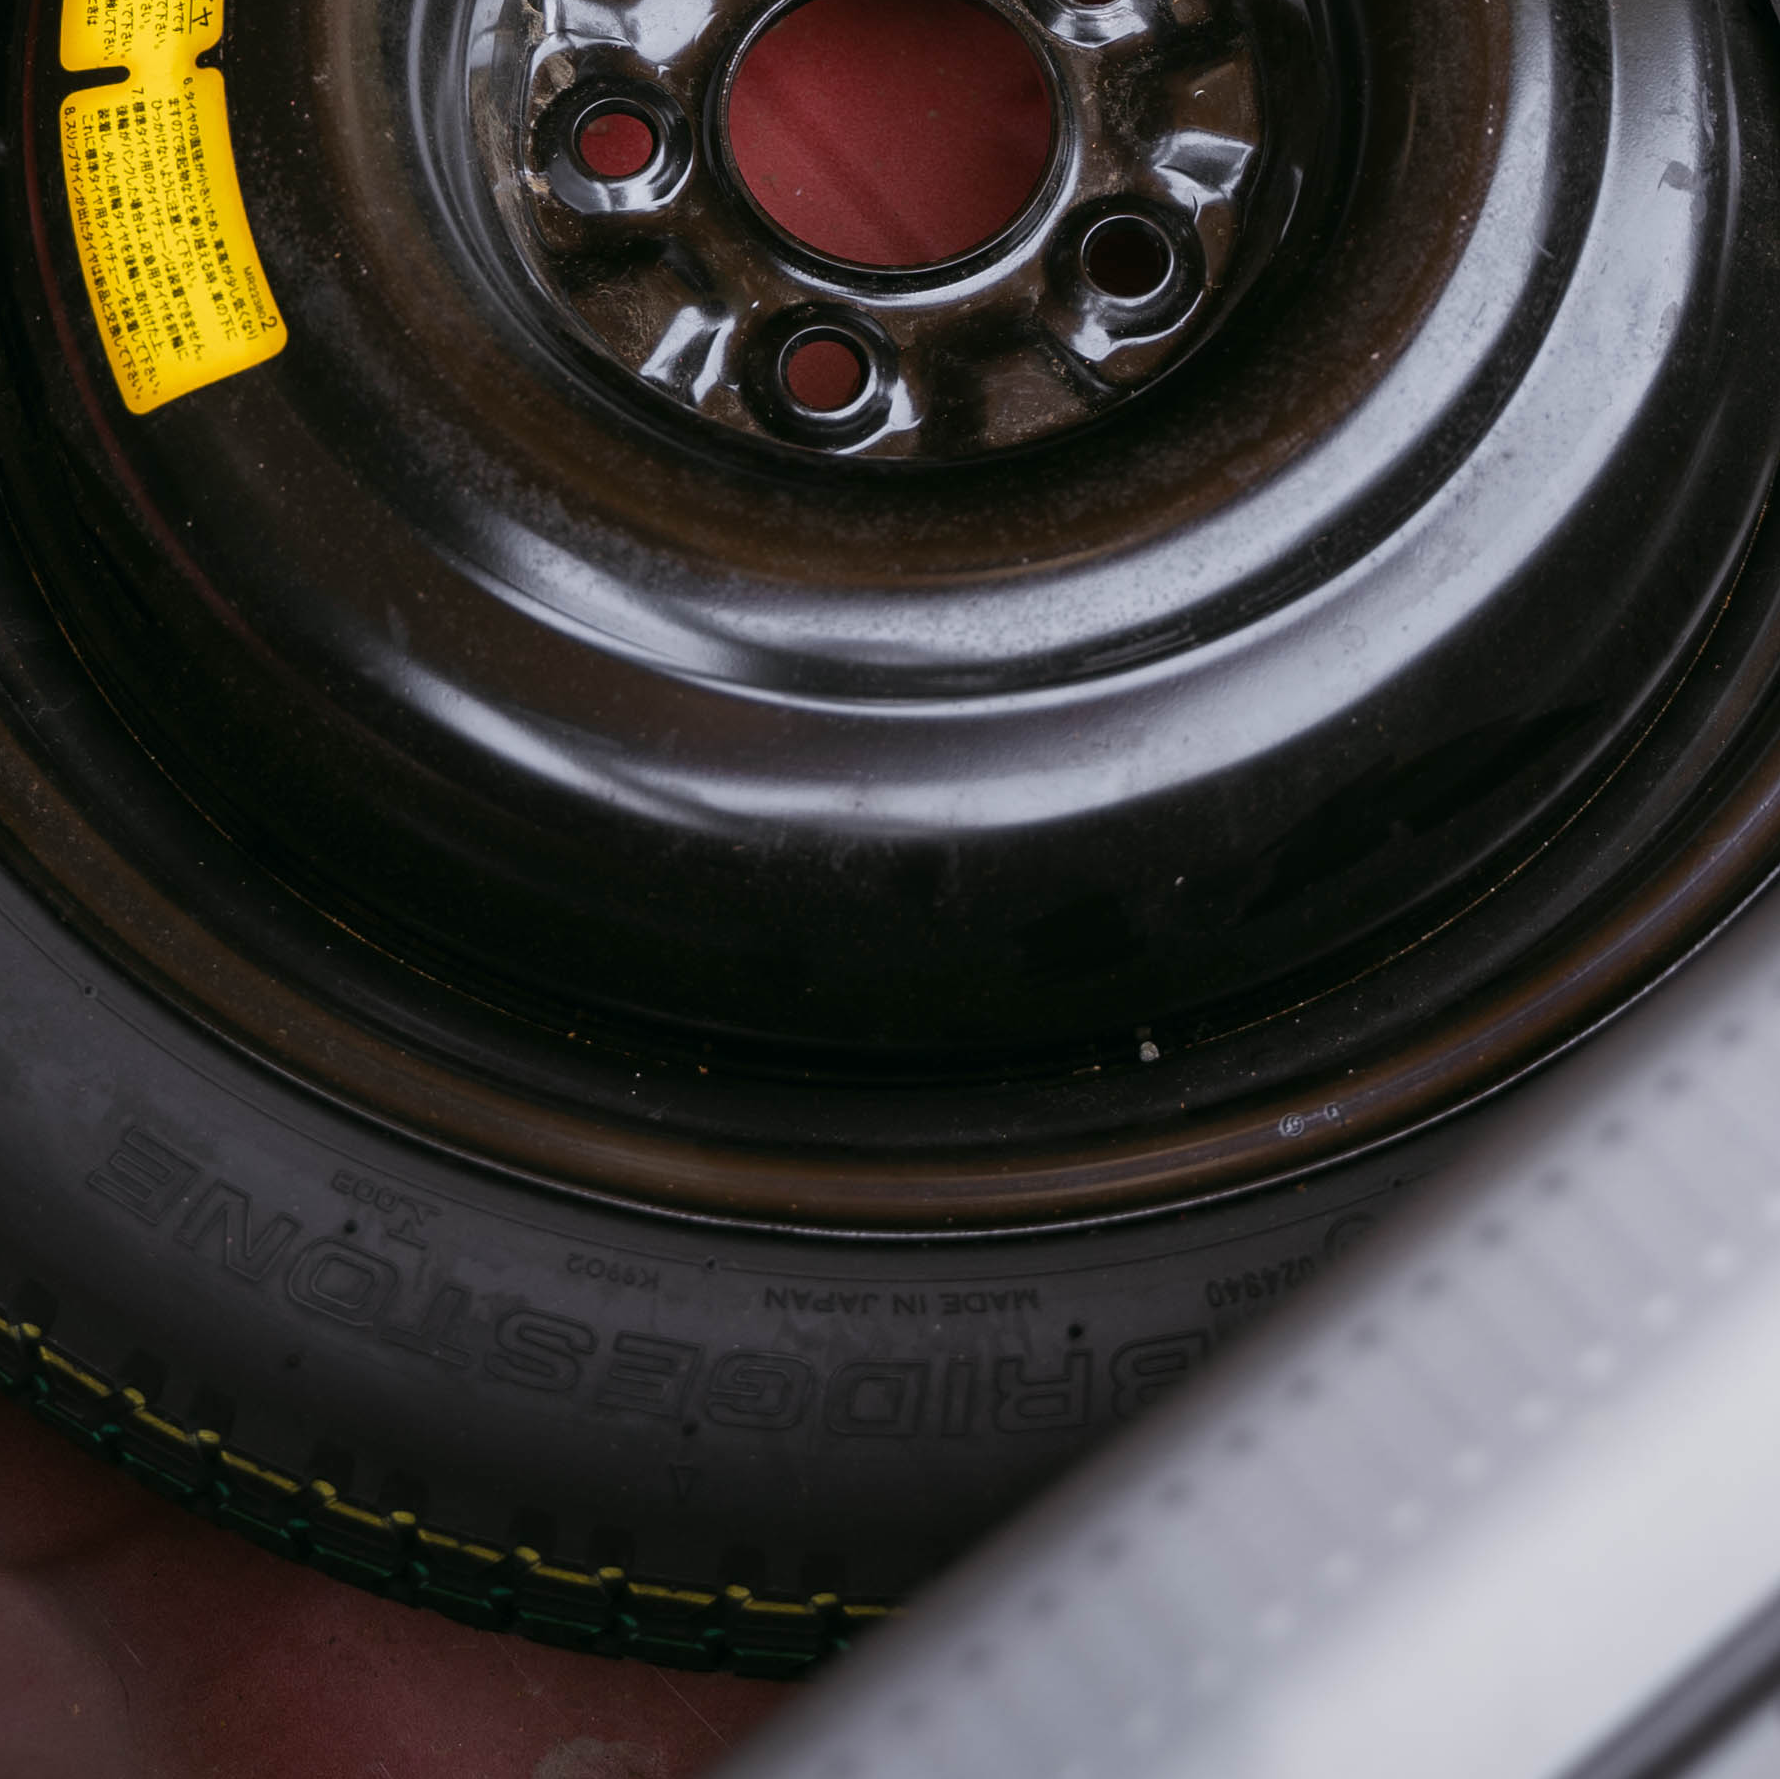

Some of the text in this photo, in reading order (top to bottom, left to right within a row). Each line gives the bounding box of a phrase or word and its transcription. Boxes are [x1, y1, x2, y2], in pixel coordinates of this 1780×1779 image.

[83, 1123, 1208, 1437] BRIDGESTONE
[764, 1286, 1039, 1314] MADE IN JAPAN
